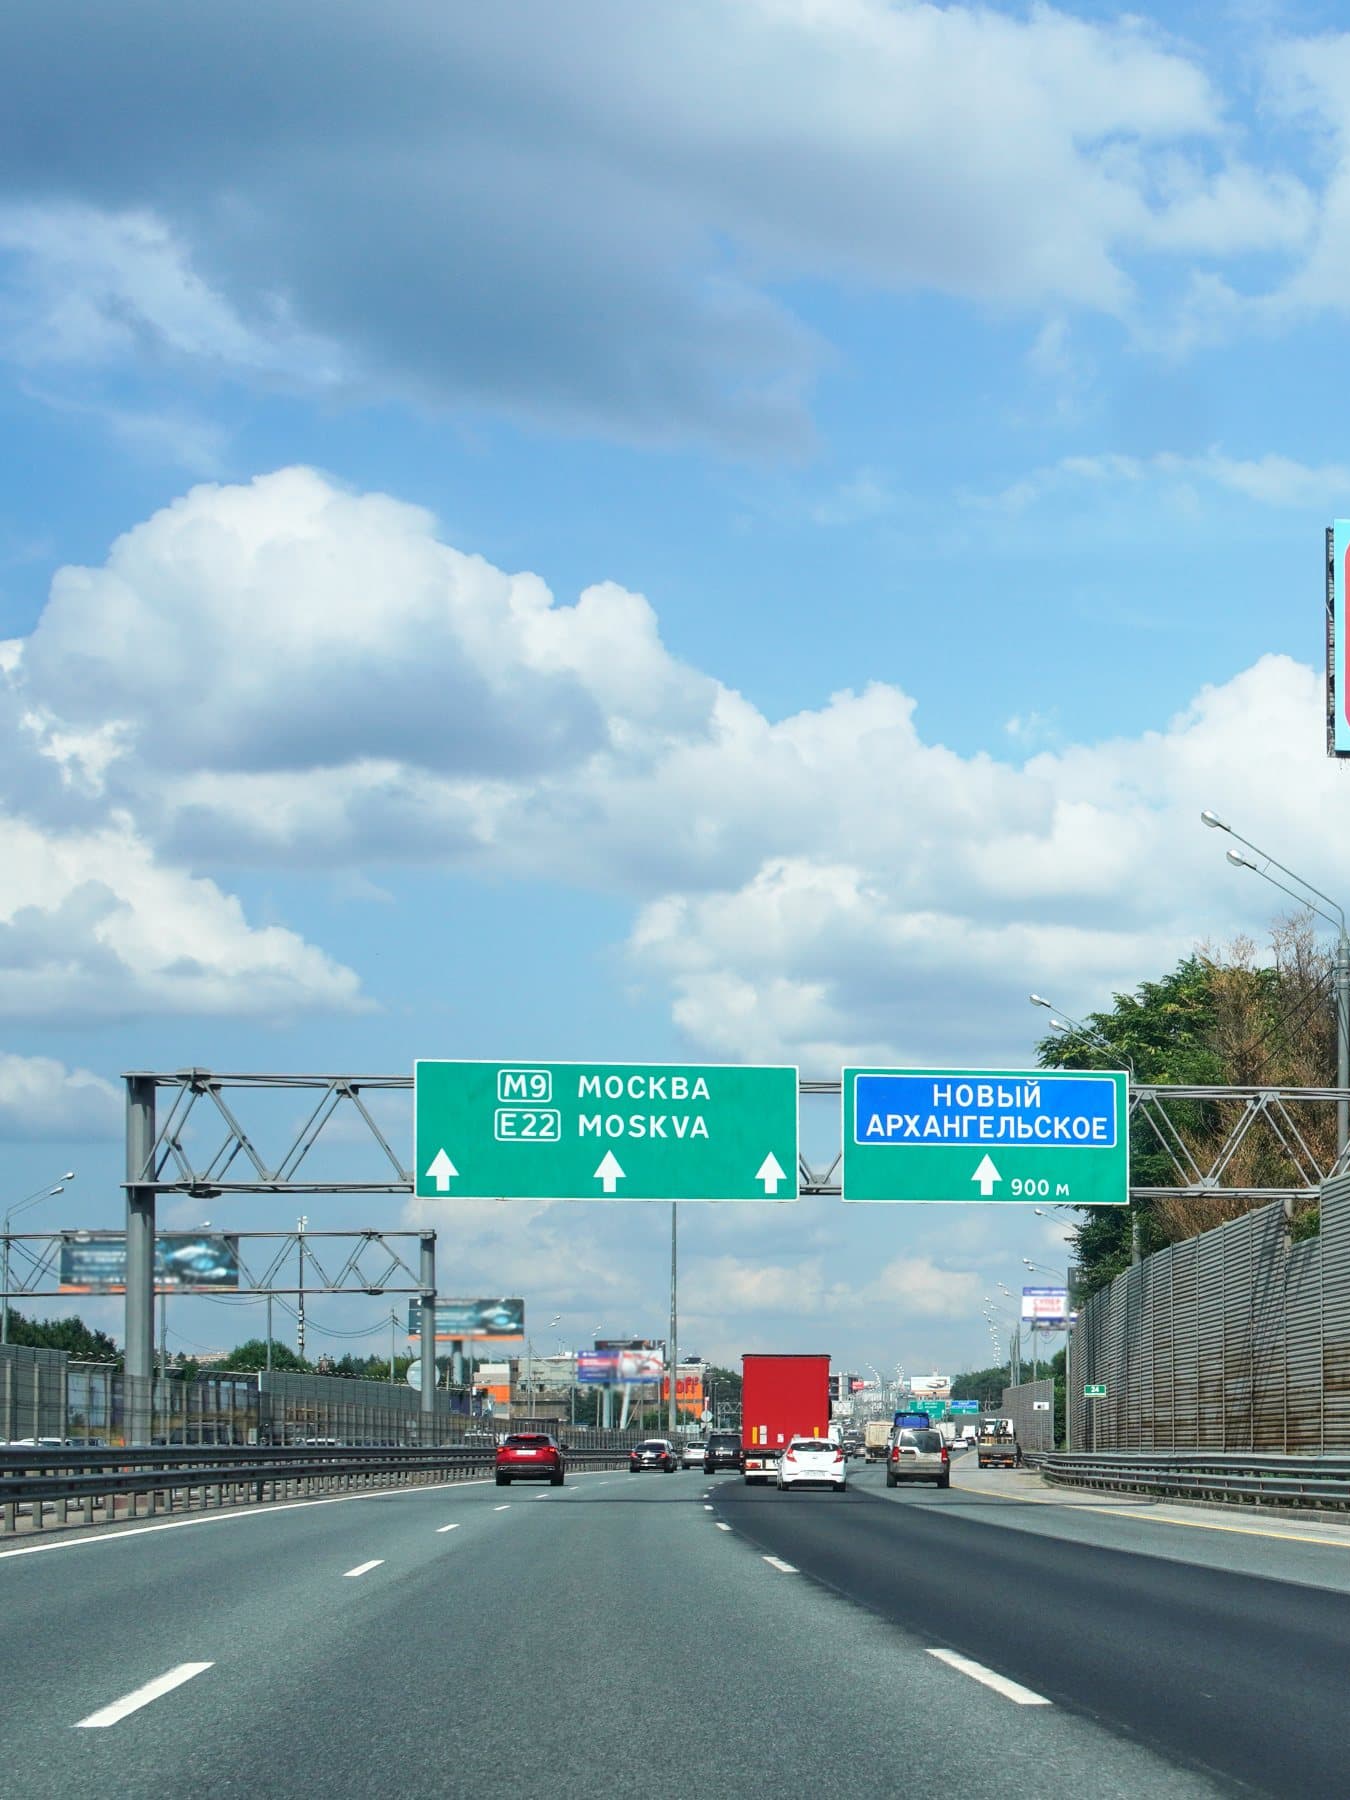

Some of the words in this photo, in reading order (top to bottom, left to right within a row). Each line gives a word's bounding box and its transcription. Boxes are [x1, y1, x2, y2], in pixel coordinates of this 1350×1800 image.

[577, 1075, 711, 1100] МОСКВА
[933, 1080, 1041, 1108] НОВЫЙ
[500, 1113, 555, 1137] E22
[578, 1114, 710, 1139] MOSKVA
[866, 1114, 1108, 1140] АРХАНГЕЛЬСКОЕ
[1011, 1178, 1050, 1196] 900
[1056, 1184, 1070, 1196] м
